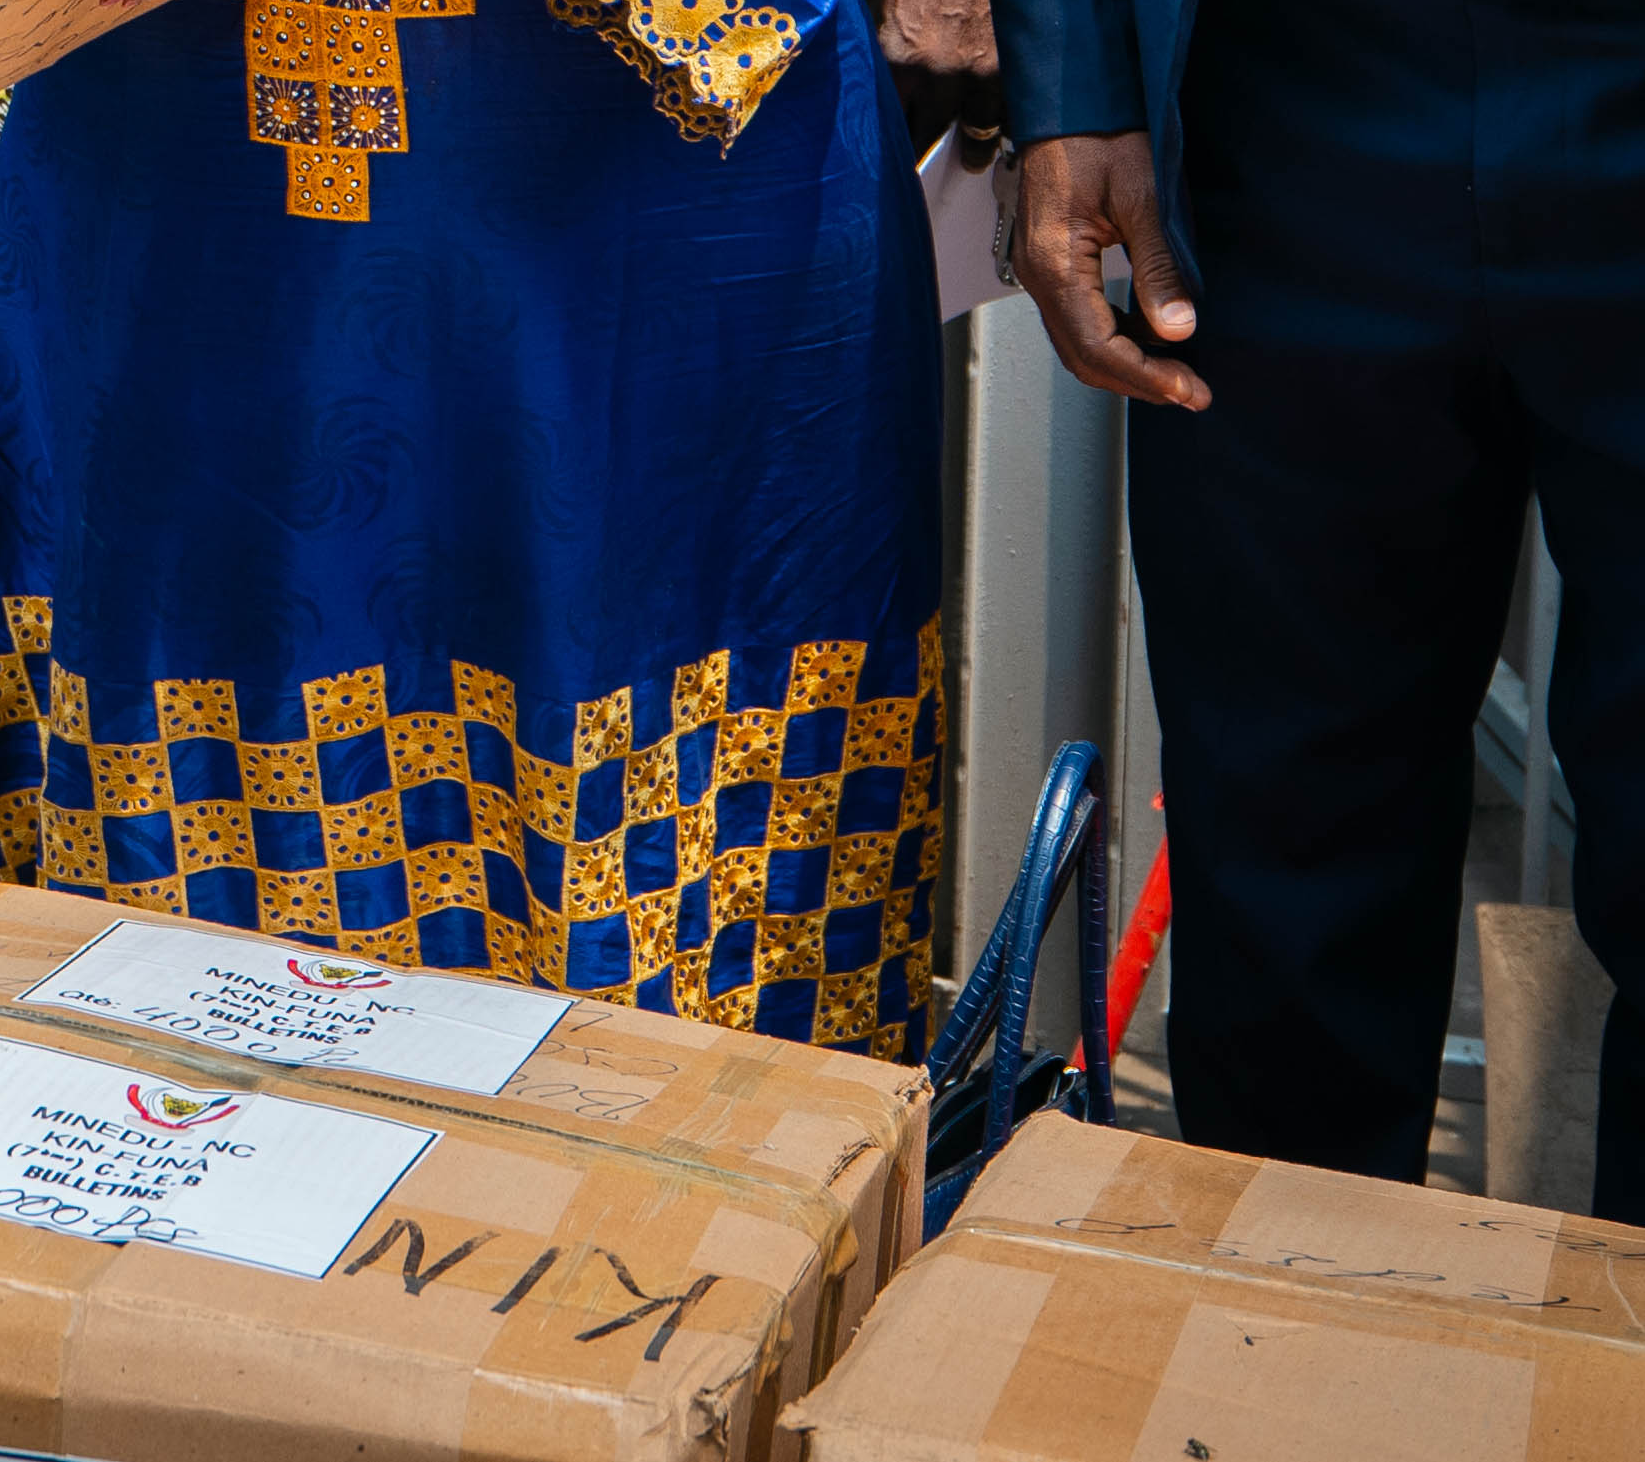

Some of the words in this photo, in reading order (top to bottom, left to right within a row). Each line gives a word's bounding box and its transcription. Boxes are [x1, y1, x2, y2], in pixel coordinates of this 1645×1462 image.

[204, 966, 339, 1006] MINEDU
[366, 1000, 416, 1016] NC
[206, 1008, 343, 1045] BULLETINS
[30, 1105, 173, 1151] MINEDU
[201, 1138, 258, 1159] NC
[21, 1164, 169, 1202] BULLETINS
